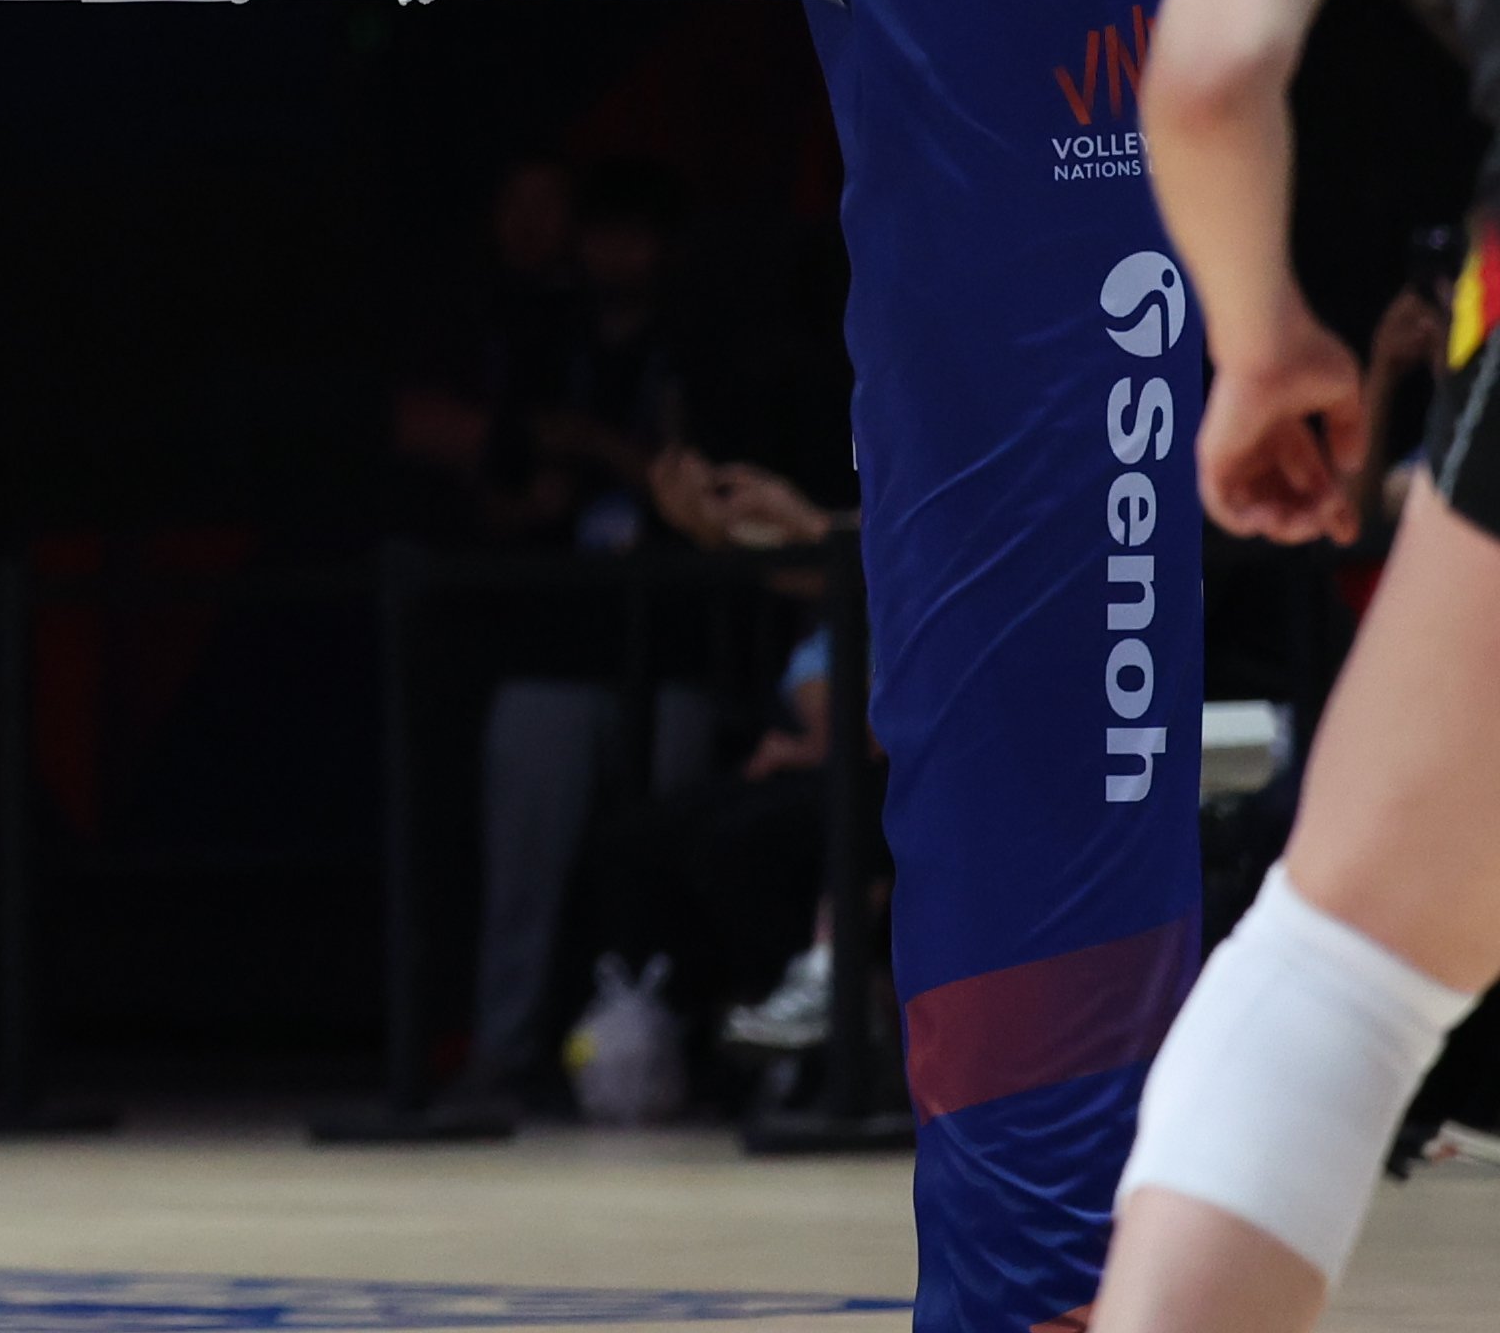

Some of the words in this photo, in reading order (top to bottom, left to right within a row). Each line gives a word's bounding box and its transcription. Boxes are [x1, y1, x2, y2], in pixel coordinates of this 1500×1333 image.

[1054, 4, 1156, 125] VN
[1054, 160, 1142, 181] NATIONS
[1105, 376, 1174, 803] Senoh
